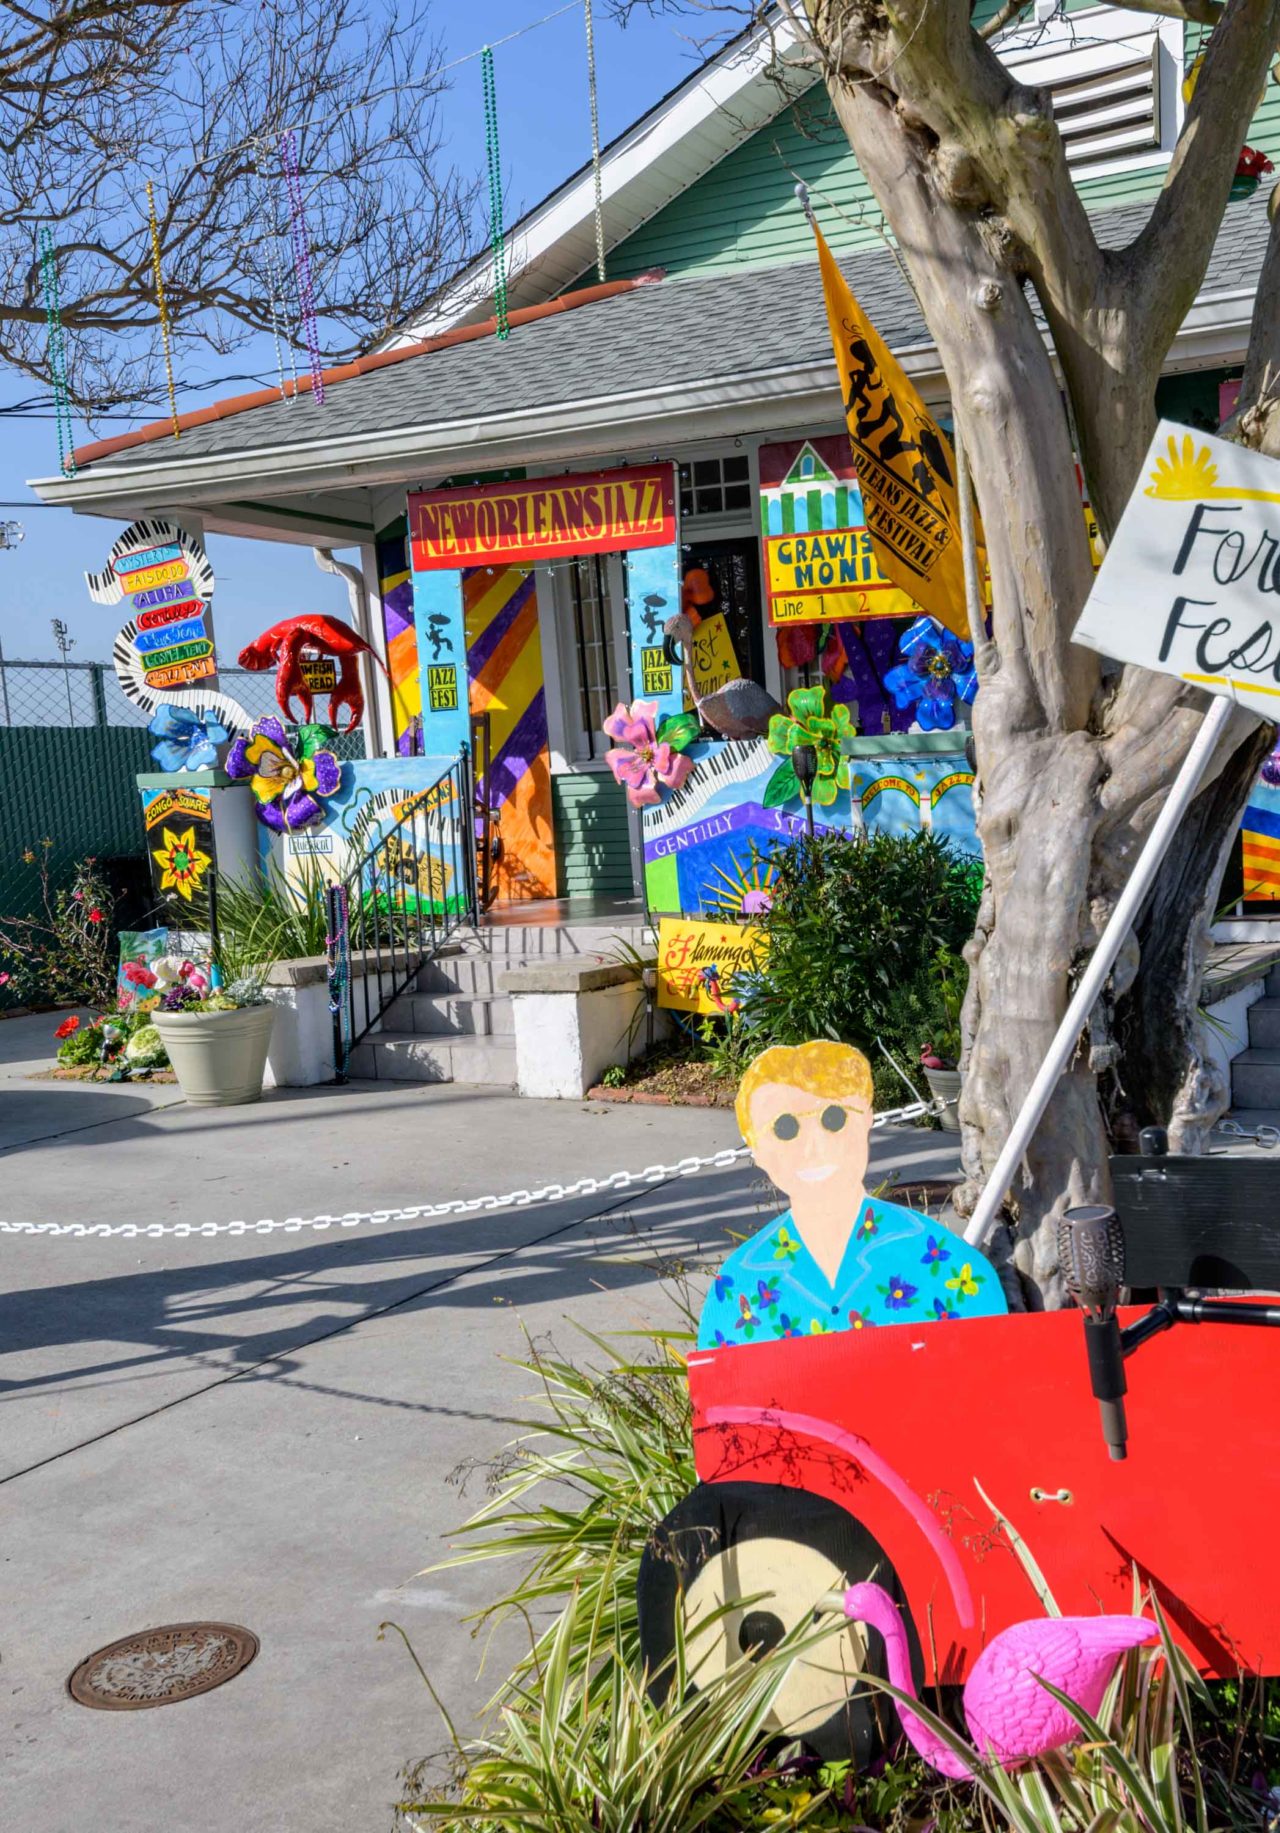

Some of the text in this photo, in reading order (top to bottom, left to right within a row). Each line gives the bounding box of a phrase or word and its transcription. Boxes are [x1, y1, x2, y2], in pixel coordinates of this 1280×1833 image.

[854, 453, 949, 545] RLEANS JAZZ &
[868, 502, 935, 567] FESTIVAL
[120, 549, 166, 570] MYSTERY
[777, 531, 874, 565] CRAWIS
[794, 556, 890, 589] MONI
[773, 597, 804, 618] Line
[858, 592, 870, 613] 2
[429, 666, 456, 688] JAZZ
[644, 672, 672, 693] FEST
[430, 690, 457, 710] FEST
[863, 778, 915, 803] WELCOME TO
[935, 774, 962, 797] JAZZ
[146, 797, 173, 822] CONGO
[178, 795, 209, 813] SQUARE
[655, 813, 733, 856] GENTILLY
[665, 932, 752, 972] Flamingo
